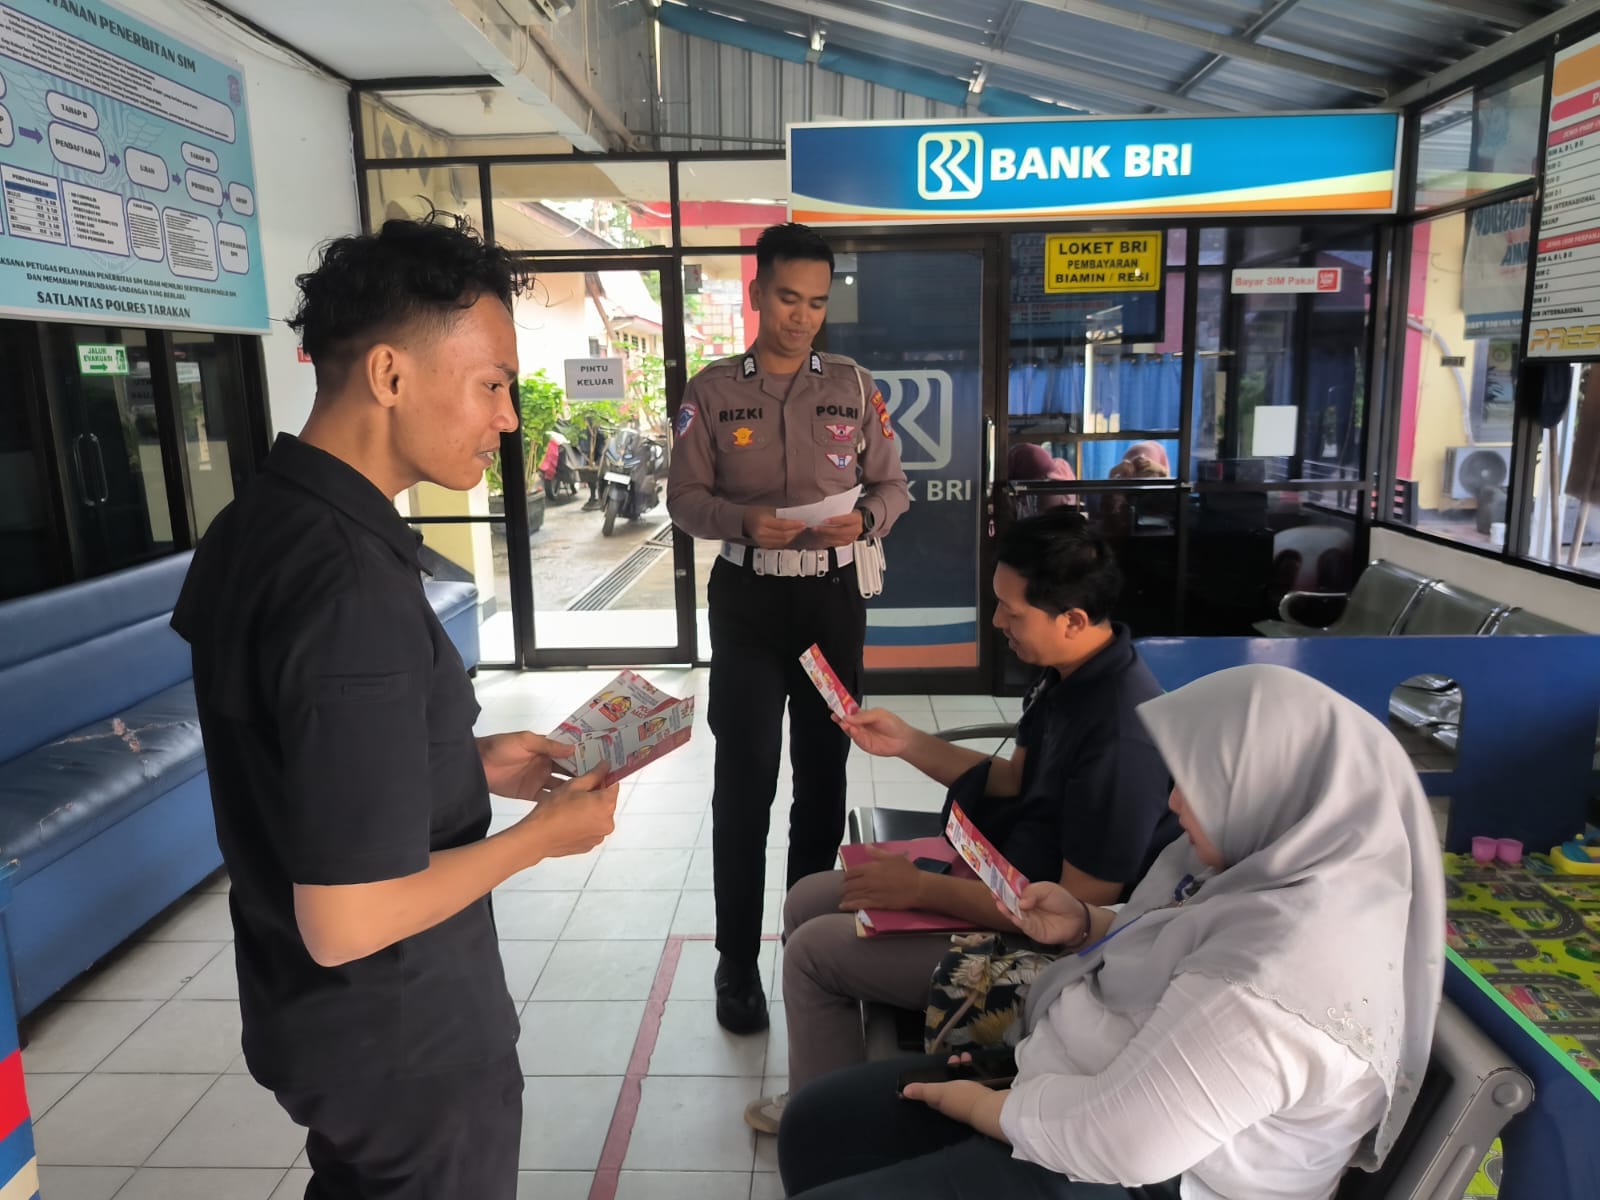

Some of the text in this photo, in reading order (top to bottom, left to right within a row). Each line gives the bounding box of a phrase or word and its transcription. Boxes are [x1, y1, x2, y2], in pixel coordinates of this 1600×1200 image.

[99, 15, 176, 63] PENERBITAN
[177, 53, 197, 73] SIM
[990, 143, 1193, 181] BANK BRI
[1059, 240, 1147, 255] LOKET BRI
[26, 260, 58, 272] PETUGAS
[58, 266, 96, 278] PELAYANAN
[1067, 259, 1138, 269] PEMBAYARAN
[26, 273, 42, 281] DAN
[42, 275, 79, 286] MEMAHAMI
[1055, 273, 1105, 283] BIAMIN
[1118, 272, 1149, 282] RESI
[1235, 277, 1264, 288] Bayar
[1266, 277, 1285, 286] SIM
[1288, 276, 1315, 286] Pakai
[37, 290, 191, 318] SATLANTAS POLRES TARAKAN
[88, 347, 107, 355] JALUR
[84, 354, 113, 362] EVAKUASI
[580, 365, 608, 373] PINTU
[577, 378, 614, 386] KELUAR
[719, 404, 858, 423] RIZKI POLRI
[927, 479, 972, 502] BRI
